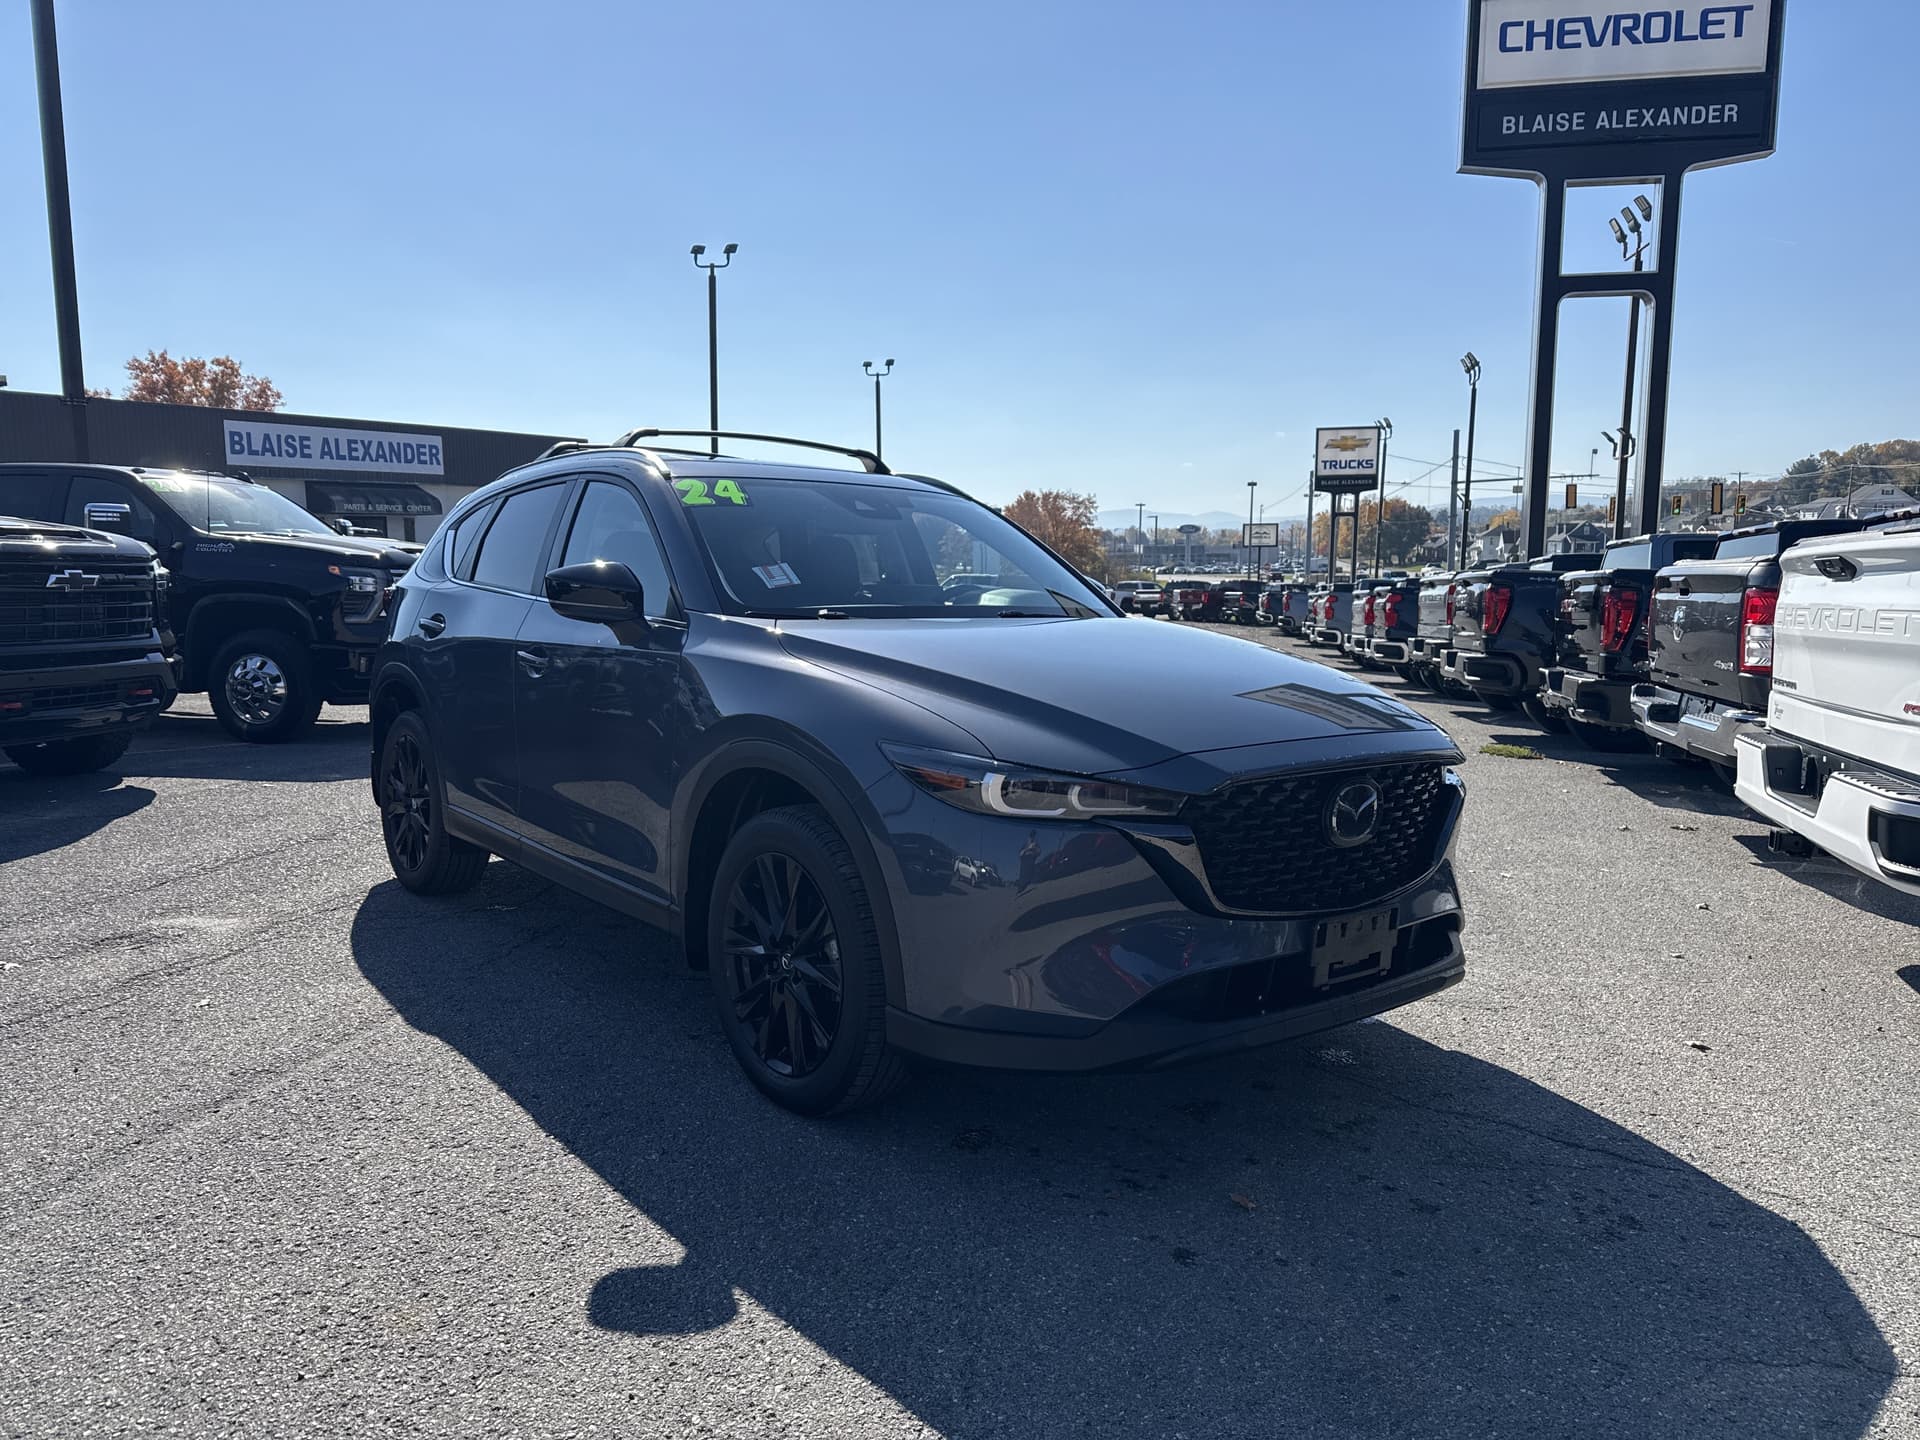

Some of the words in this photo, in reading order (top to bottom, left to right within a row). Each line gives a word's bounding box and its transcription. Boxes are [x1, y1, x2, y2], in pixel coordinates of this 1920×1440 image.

[1499, 4, 1754, 53] CHEVROLET
[1502, 112, 1586, 135] BLAISE
[1595, 103, 1739, 130] ALEXANDER
[228, 430, 313, 459] BLAISE
[319, 437, 442, 466] ALEXANDER
[1321, 459, 1374, 470] TRUCKS
[675, 479, 748, 505] 24
[343, 503, 366, 511] PARTS
[367, 503, 373, 511] &
[375, 504, 403, 512] SERVICE
[406, 504, 432, 513] CENTER
